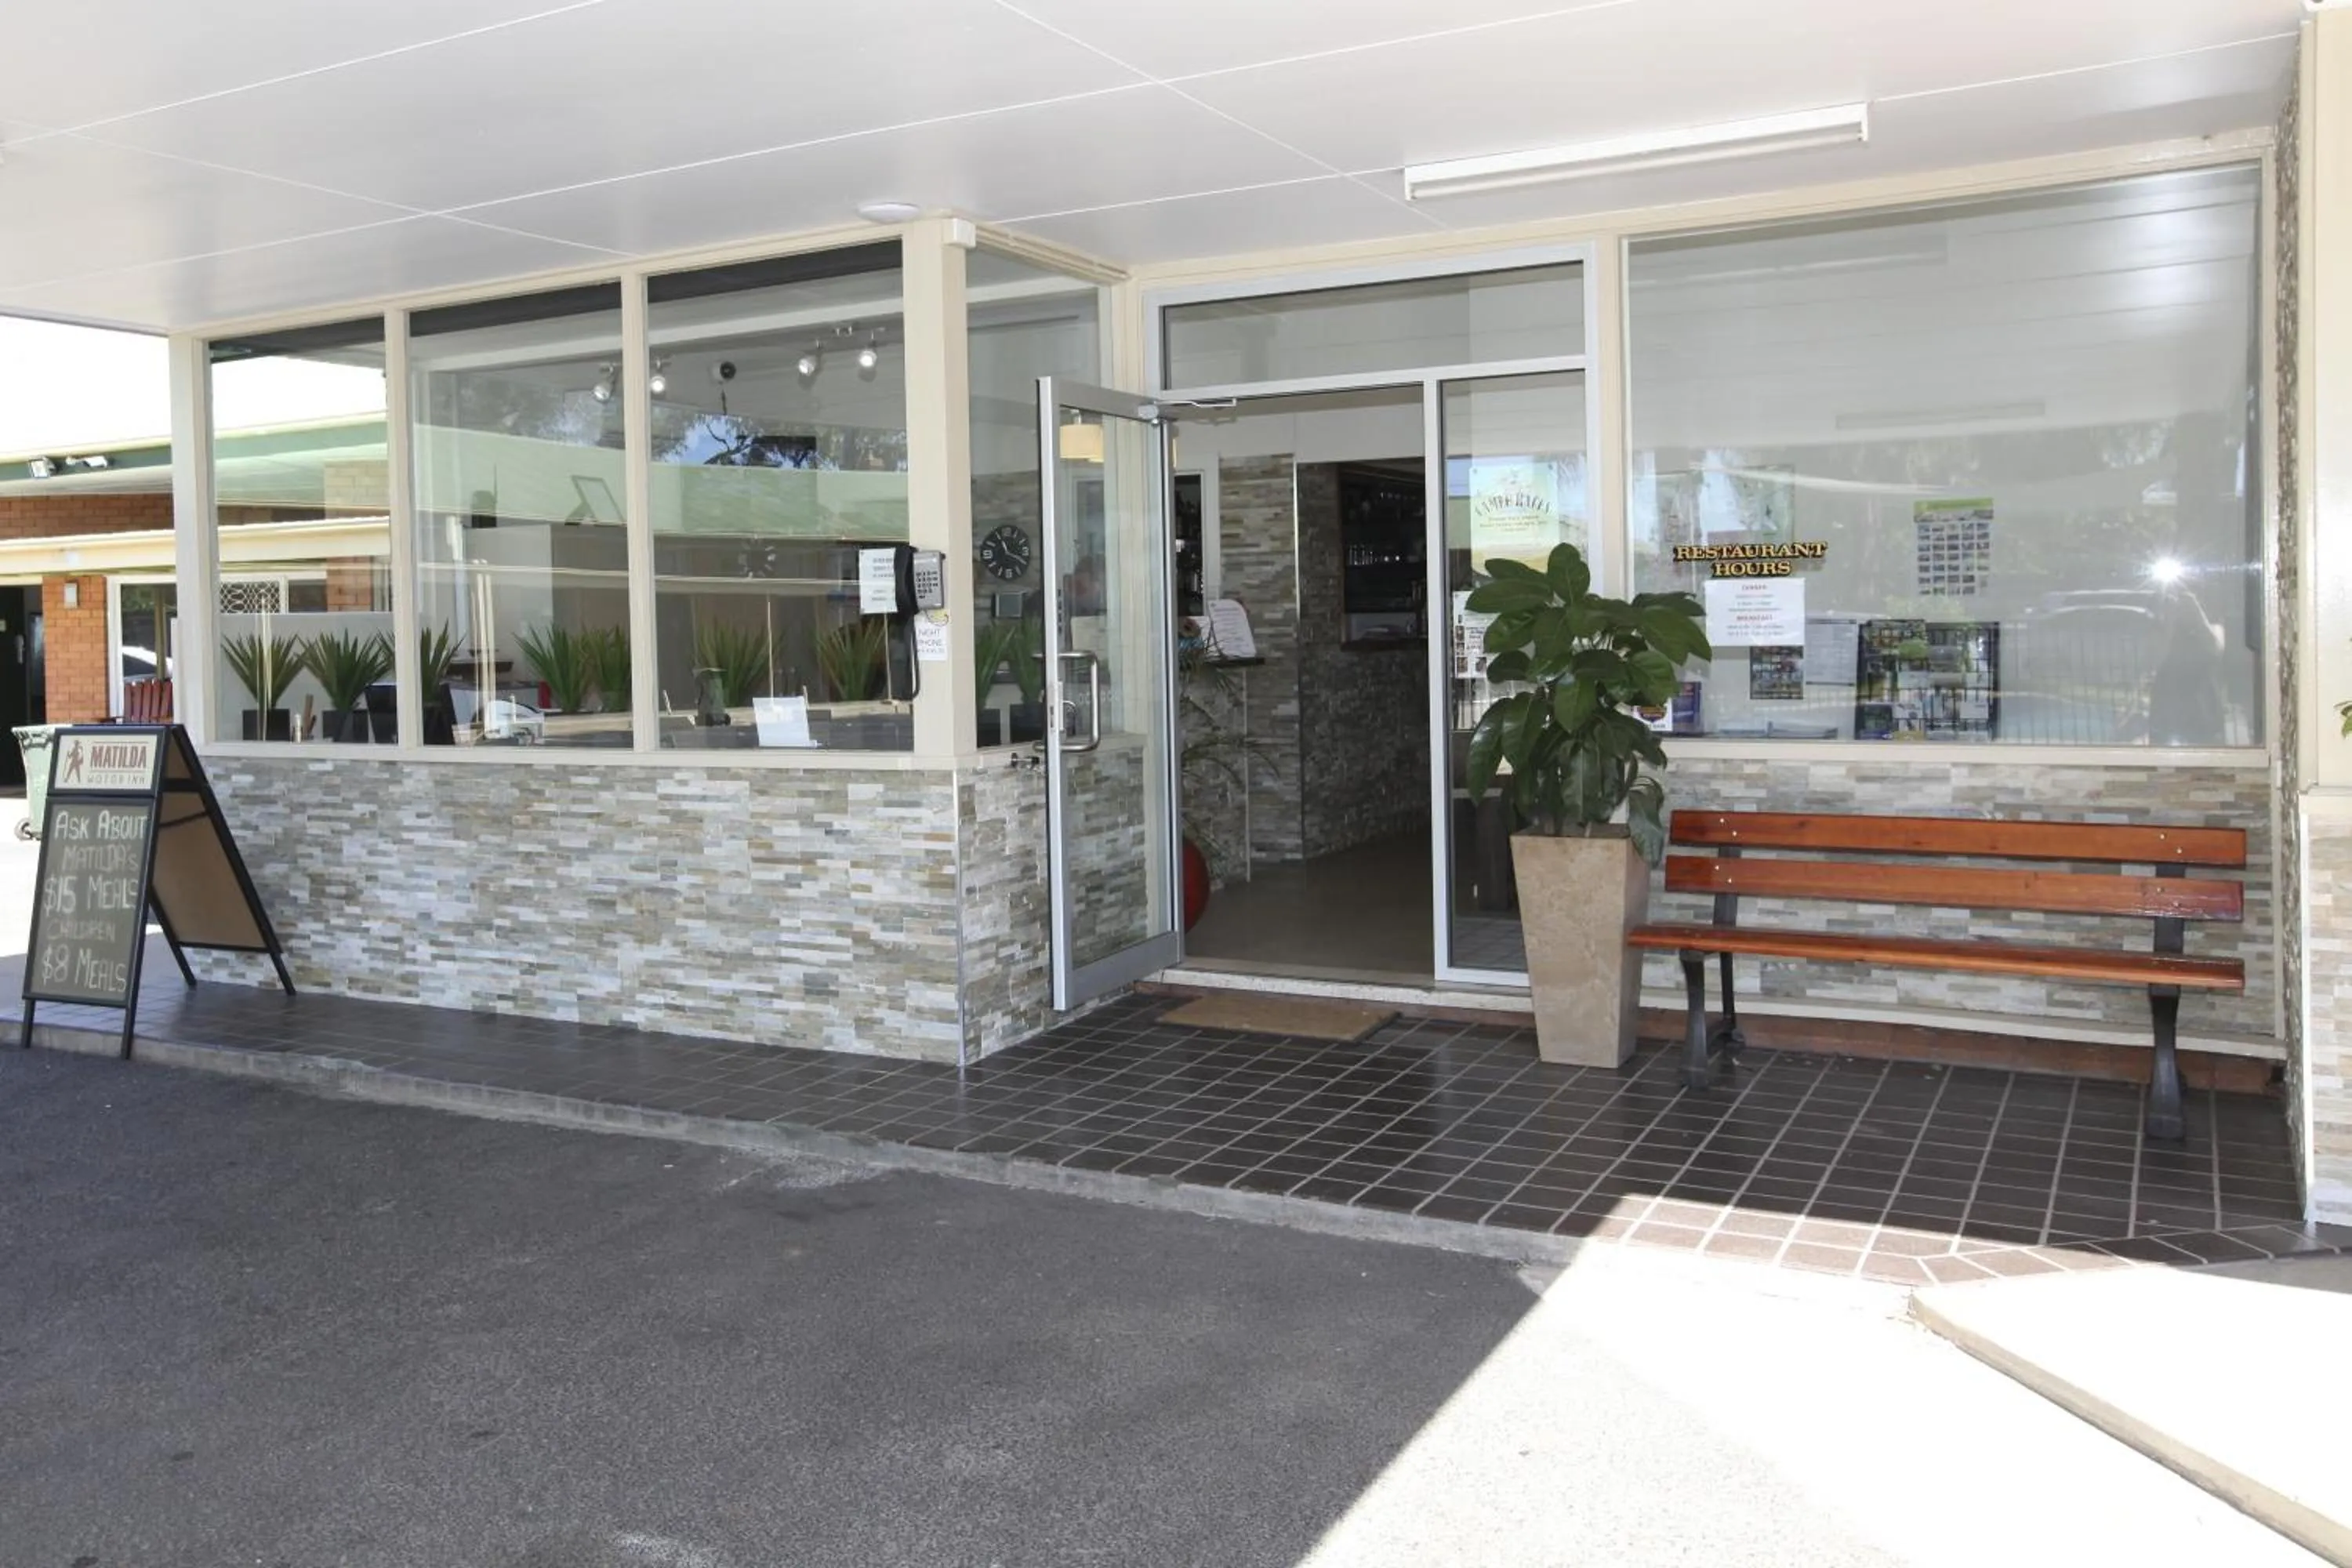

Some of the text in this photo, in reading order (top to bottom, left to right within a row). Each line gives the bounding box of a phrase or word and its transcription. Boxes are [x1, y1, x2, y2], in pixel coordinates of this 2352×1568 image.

[1674, 542, 1827, 561] RESTAURANT
[1711, 561, 1791, 577] HOURS
[89, 746, 147, 768] MATILDA
[43, 874, 138, 916] $15 MEALS
[42, 943, 127, 993] $8 MEALS
